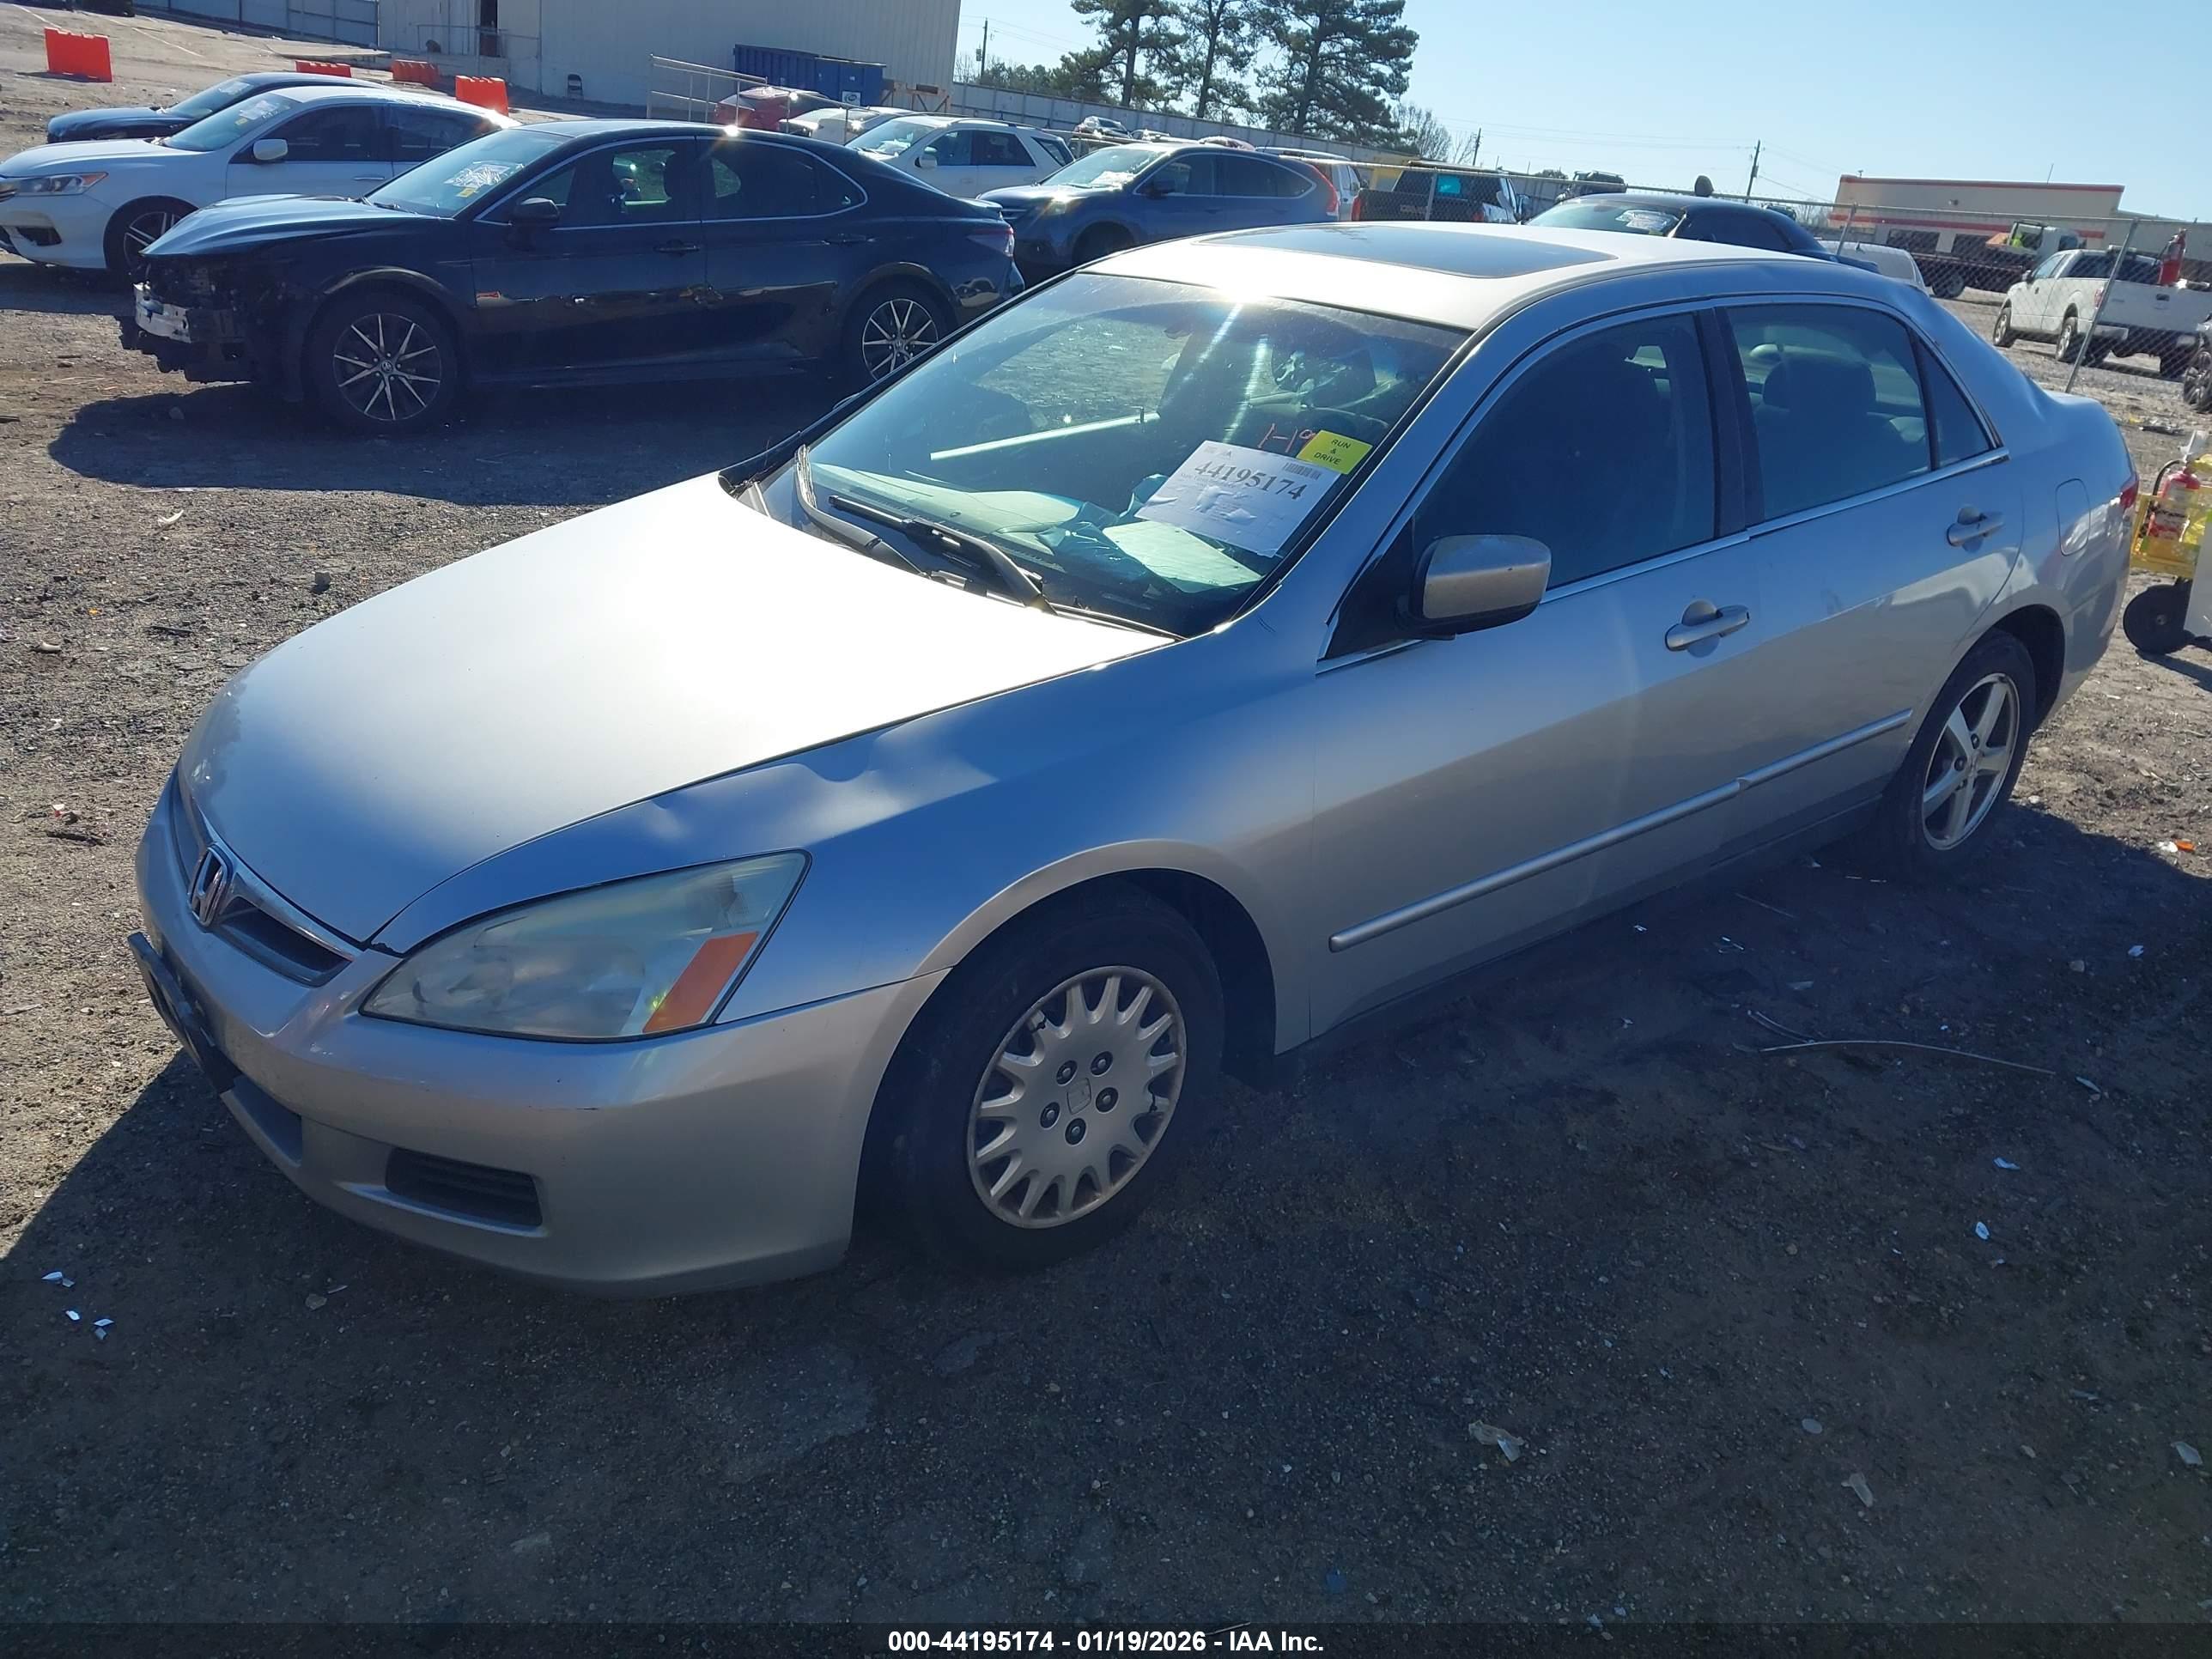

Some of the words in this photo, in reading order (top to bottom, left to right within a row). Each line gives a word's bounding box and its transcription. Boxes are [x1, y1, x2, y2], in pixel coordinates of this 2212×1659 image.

[1331, 438, 1352, 450] RUN
[1313, 452, 1341, 465] DRIVE
[1194, 461, 1308, 500] 44195174
